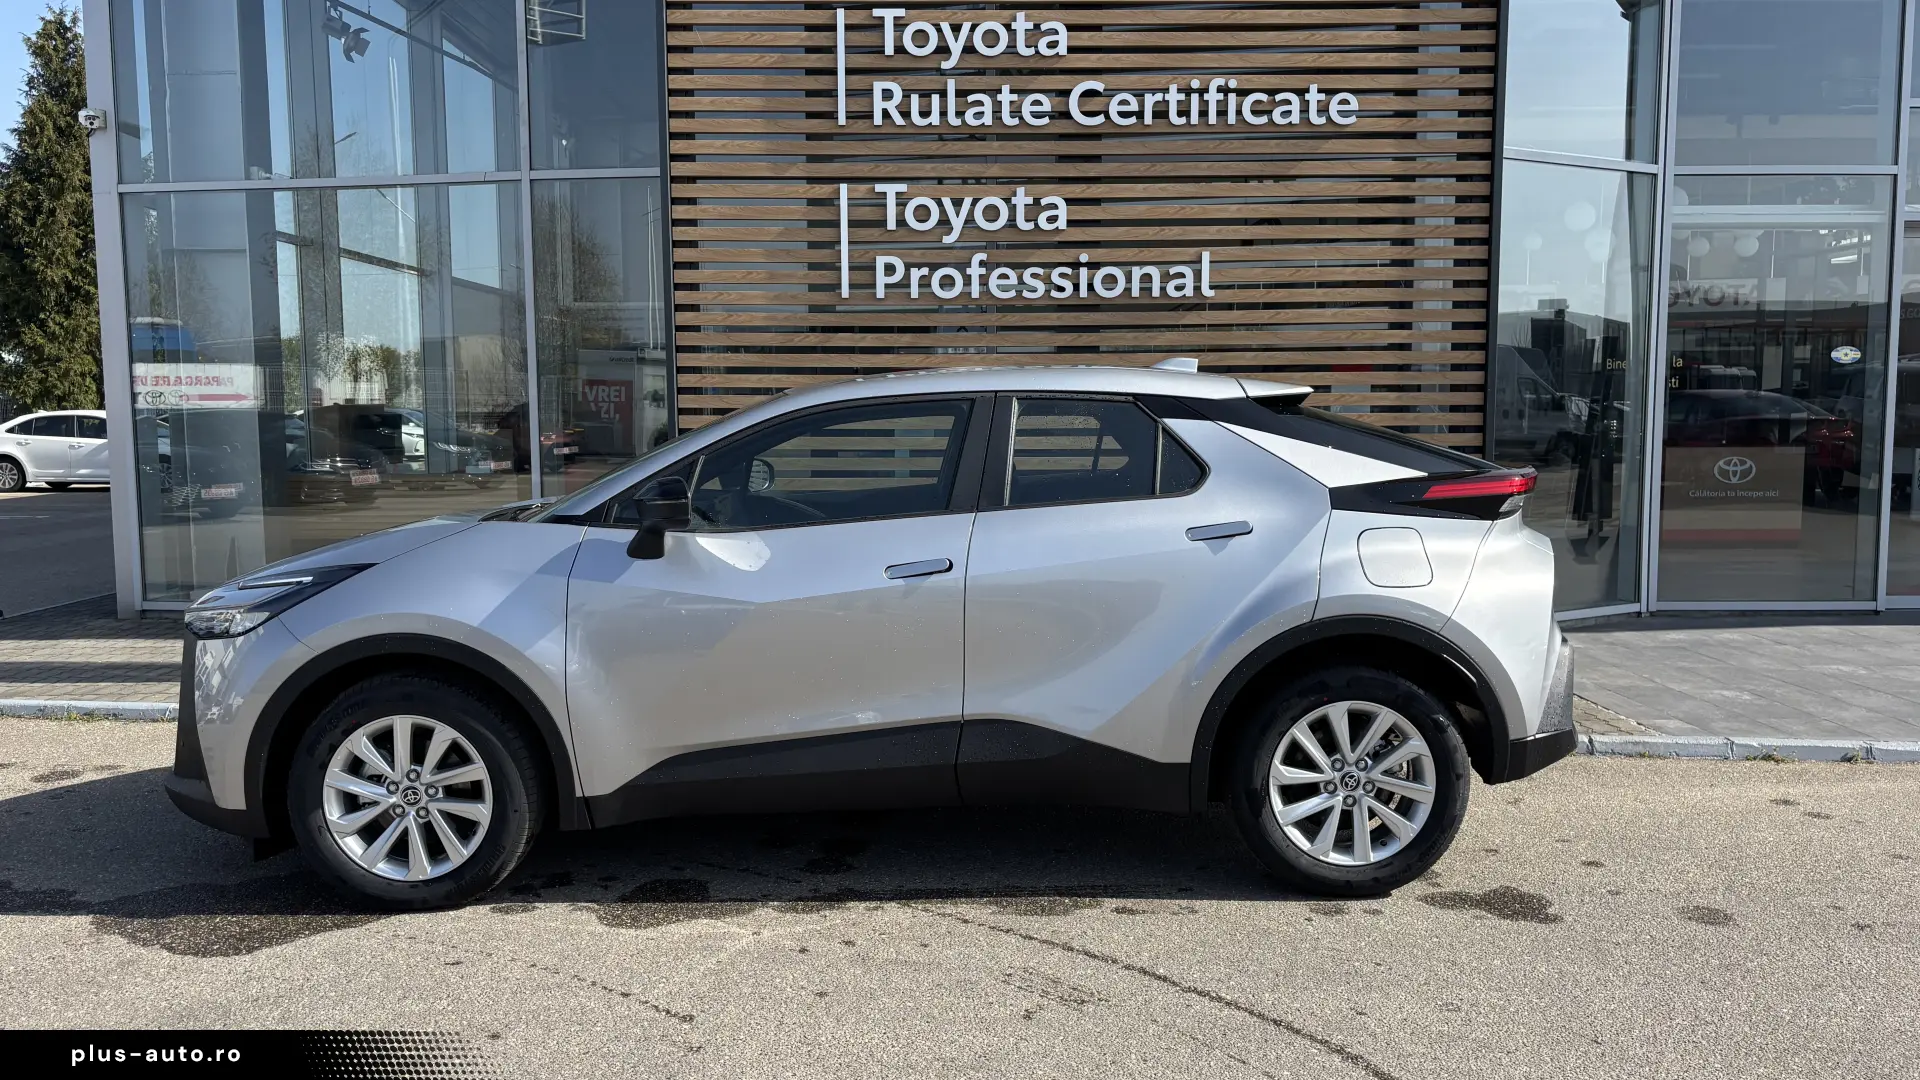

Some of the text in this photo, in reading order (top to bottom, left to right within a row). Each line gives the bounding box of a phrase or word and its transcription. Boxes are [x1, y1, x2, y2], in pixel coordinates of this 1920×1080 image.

[872, 8, 1068, 69] Toyota
[872, 78, 1360, 127] Rulate Certificate
[874, 184, 1068, 244] Toyota
[875, 251, 1215, 299] Professional
[1672, 355, 1683, 367] la
[585, 385, 626, 401] VREI
